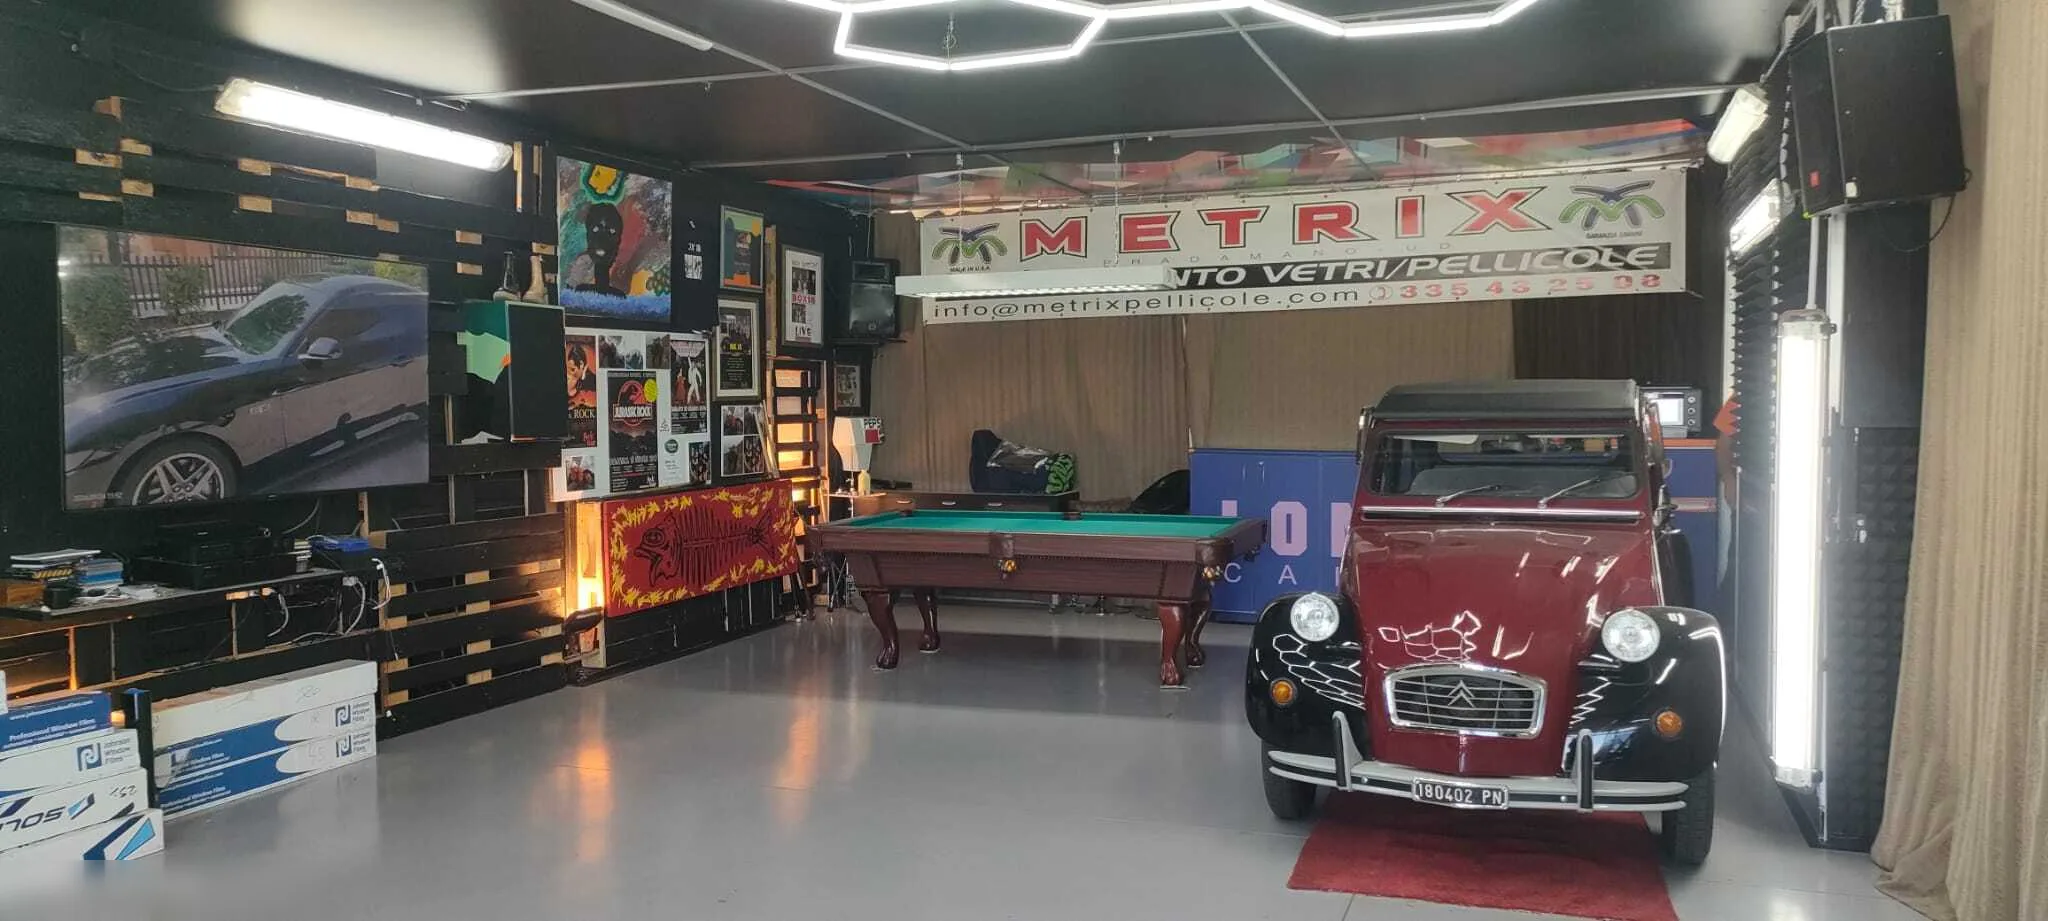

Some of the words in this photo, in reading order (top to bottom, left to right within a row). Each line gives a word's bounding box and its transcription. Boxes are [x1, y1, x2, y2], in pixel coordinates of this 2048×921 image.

[1020, 186, 1552, 262] METRIX
[1264, 246, 1660, 284] VETRI/PELLICOLE
[1400, 280, 1469, 299] 335
[1488, 278, 1531, 298] 43
[934, 288, 1358, 318] info@metrixpellicole.com
[574, 408, 596, 418] ROCK
[1419, 783, 1473, 803] 180402
[1481, 789, 1503, 805] PN
